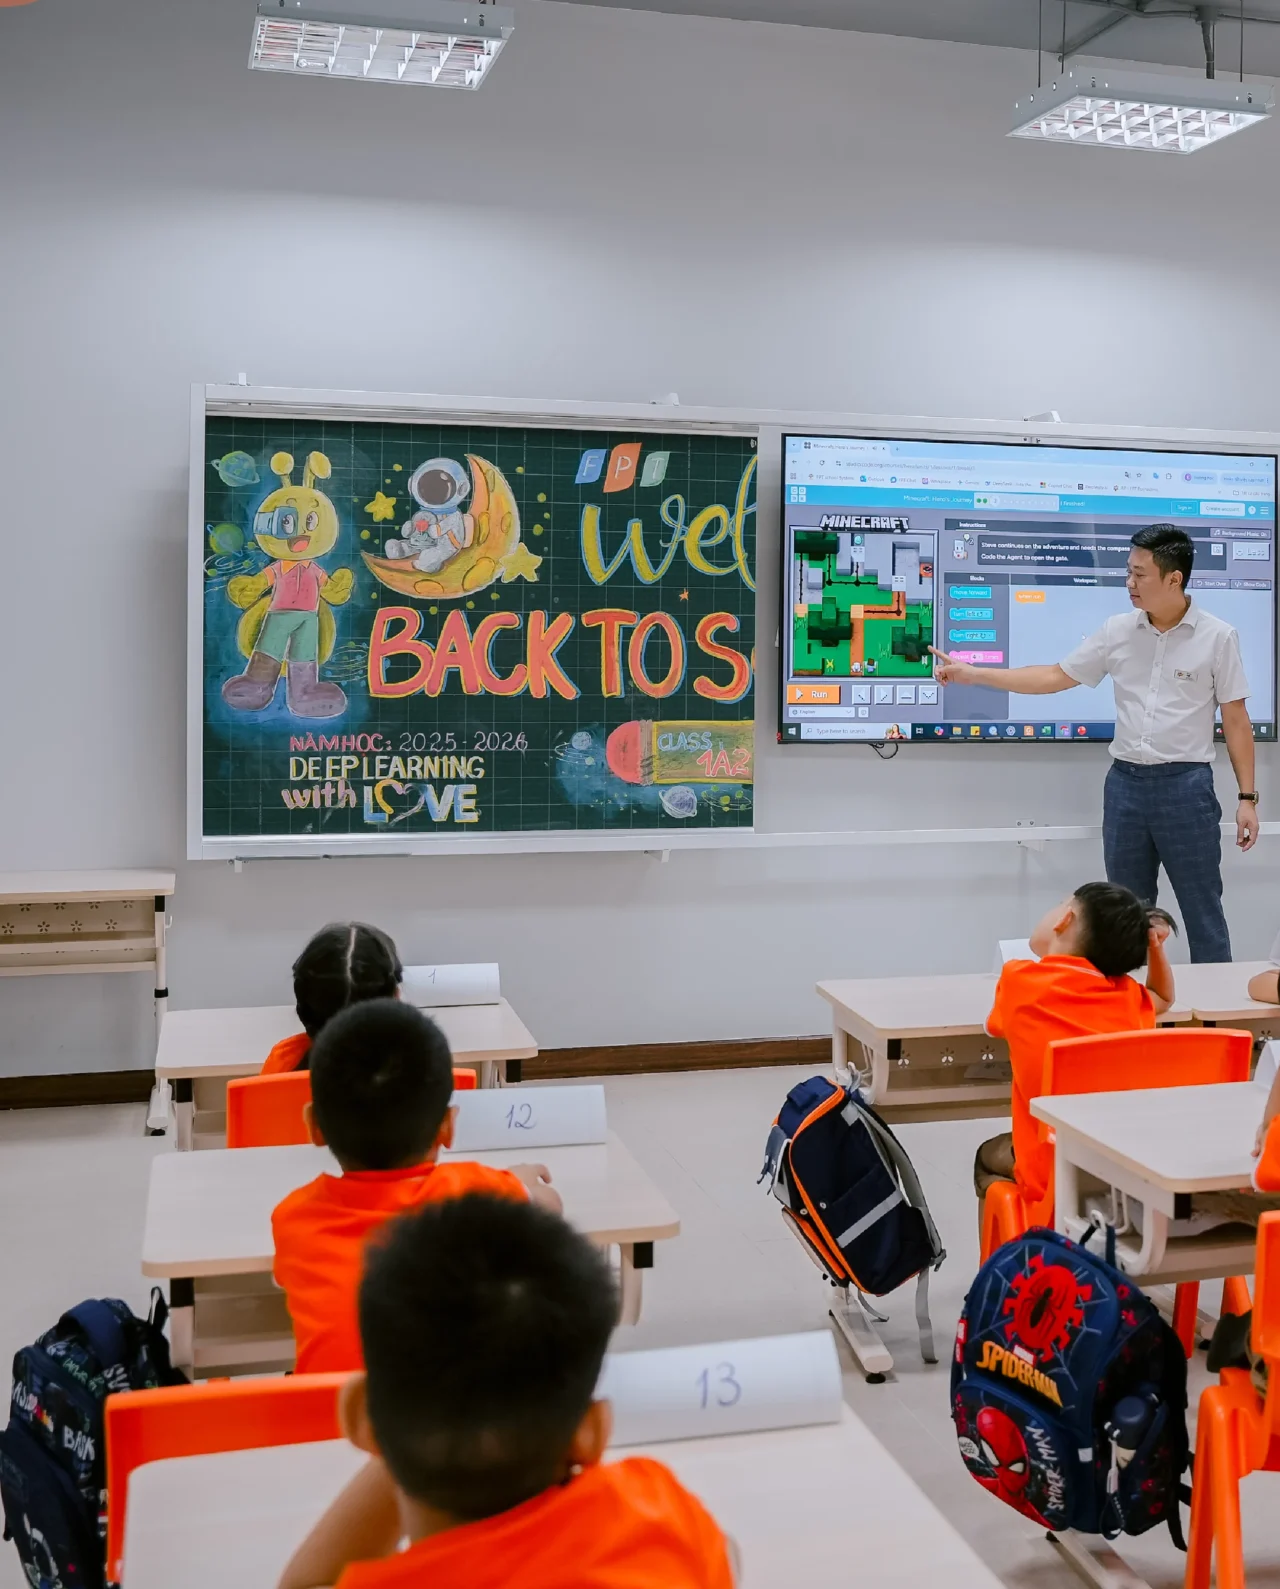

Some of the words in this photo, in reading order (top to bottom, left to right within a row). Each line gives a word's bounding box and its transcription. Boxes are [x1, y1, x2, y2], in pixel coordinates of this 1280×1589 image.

[820, 514, 909, 530] MINECRAFT
[367, 606, 581, 699] BACK
[582, 609, 687, 699] TO
[811, 690, 828, 699] Run
[399, 732, 458, 752] 2025
[816, 728, 829, 736] Type
[289, 755, 360, 781] DEEP
[362, 755, 486, 780] LEARNING
[696, 748, 752, 777] 1A2
[281, 778, 358, 809] with
[427, 968, 437, 984] 1
[505, 1103, 537, 1130] 12
[694, 1361, 742, 1410] 13
[976, 1340, 1064, 1408] SPIDER-MAN
